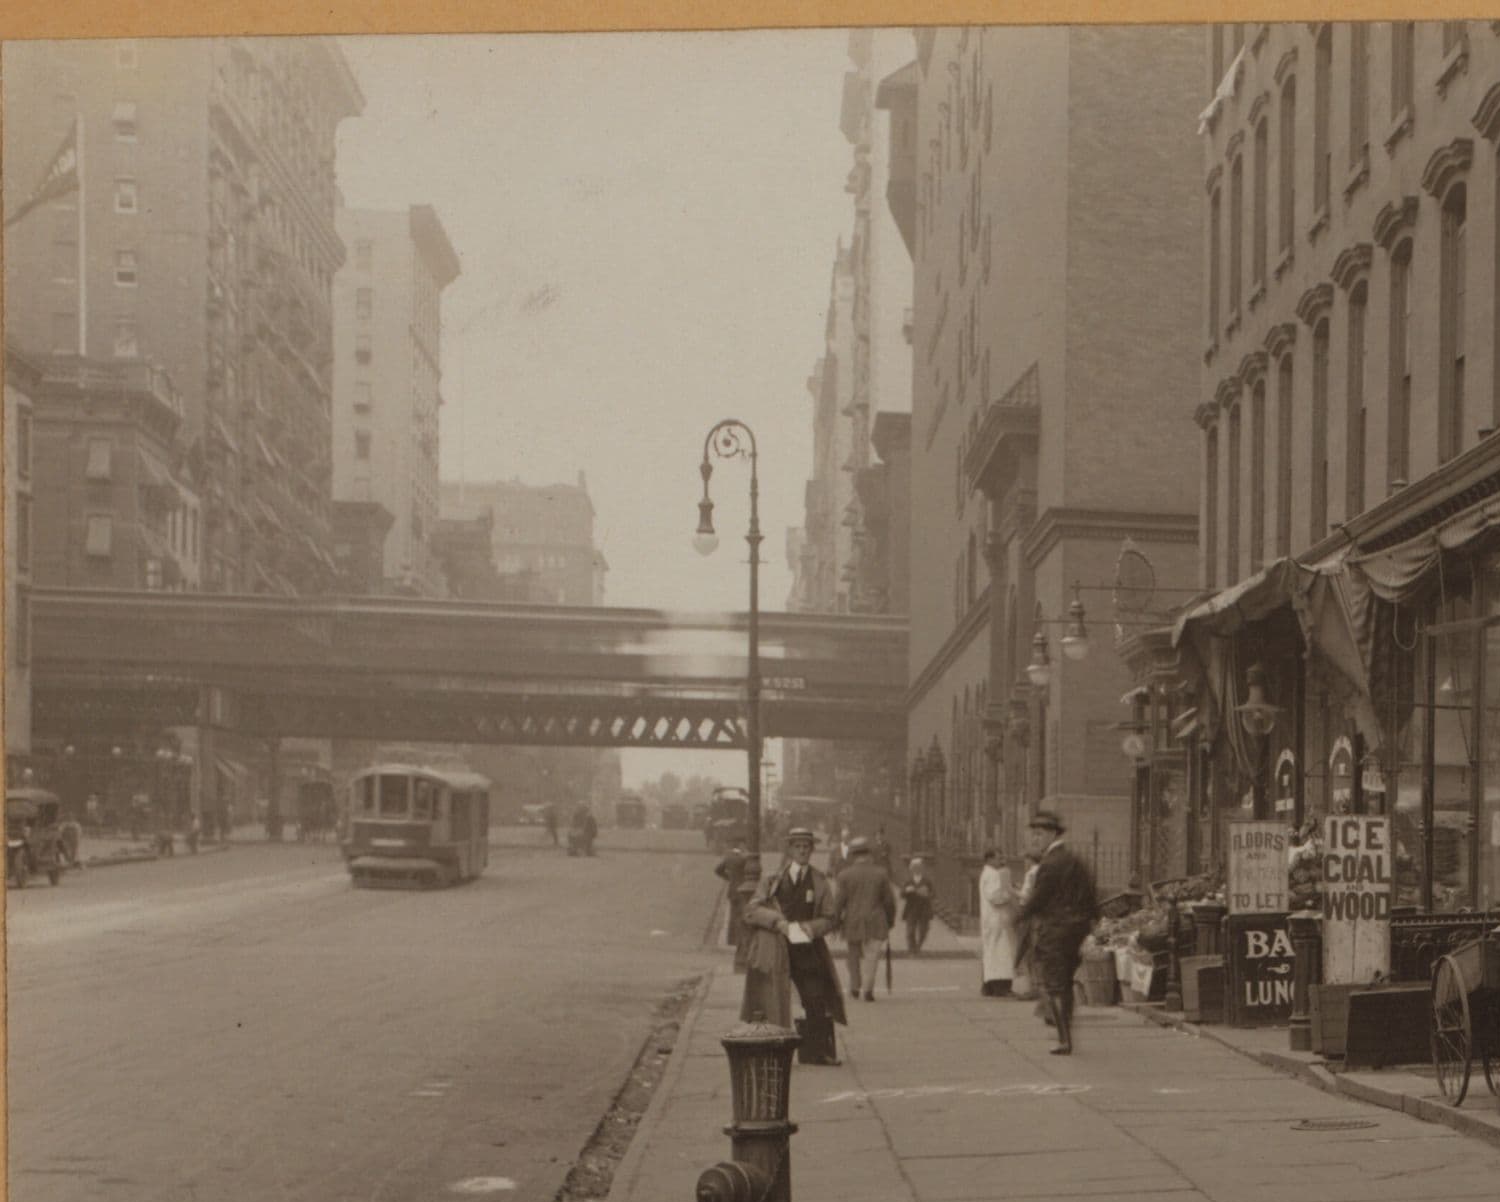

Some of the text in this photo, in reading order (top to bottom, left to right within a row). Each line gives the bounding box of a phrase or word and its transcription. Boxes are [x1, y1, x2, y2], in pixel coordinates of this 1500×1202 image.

[1330, 820, 1385, 850] ICE
[1323, 854, 1391, 884] COAL
[1233, 893, 1284, 909] TO LET
[1324, 891, 1391, 921] WOOD
[1245, 929, 1297, 959] BA
